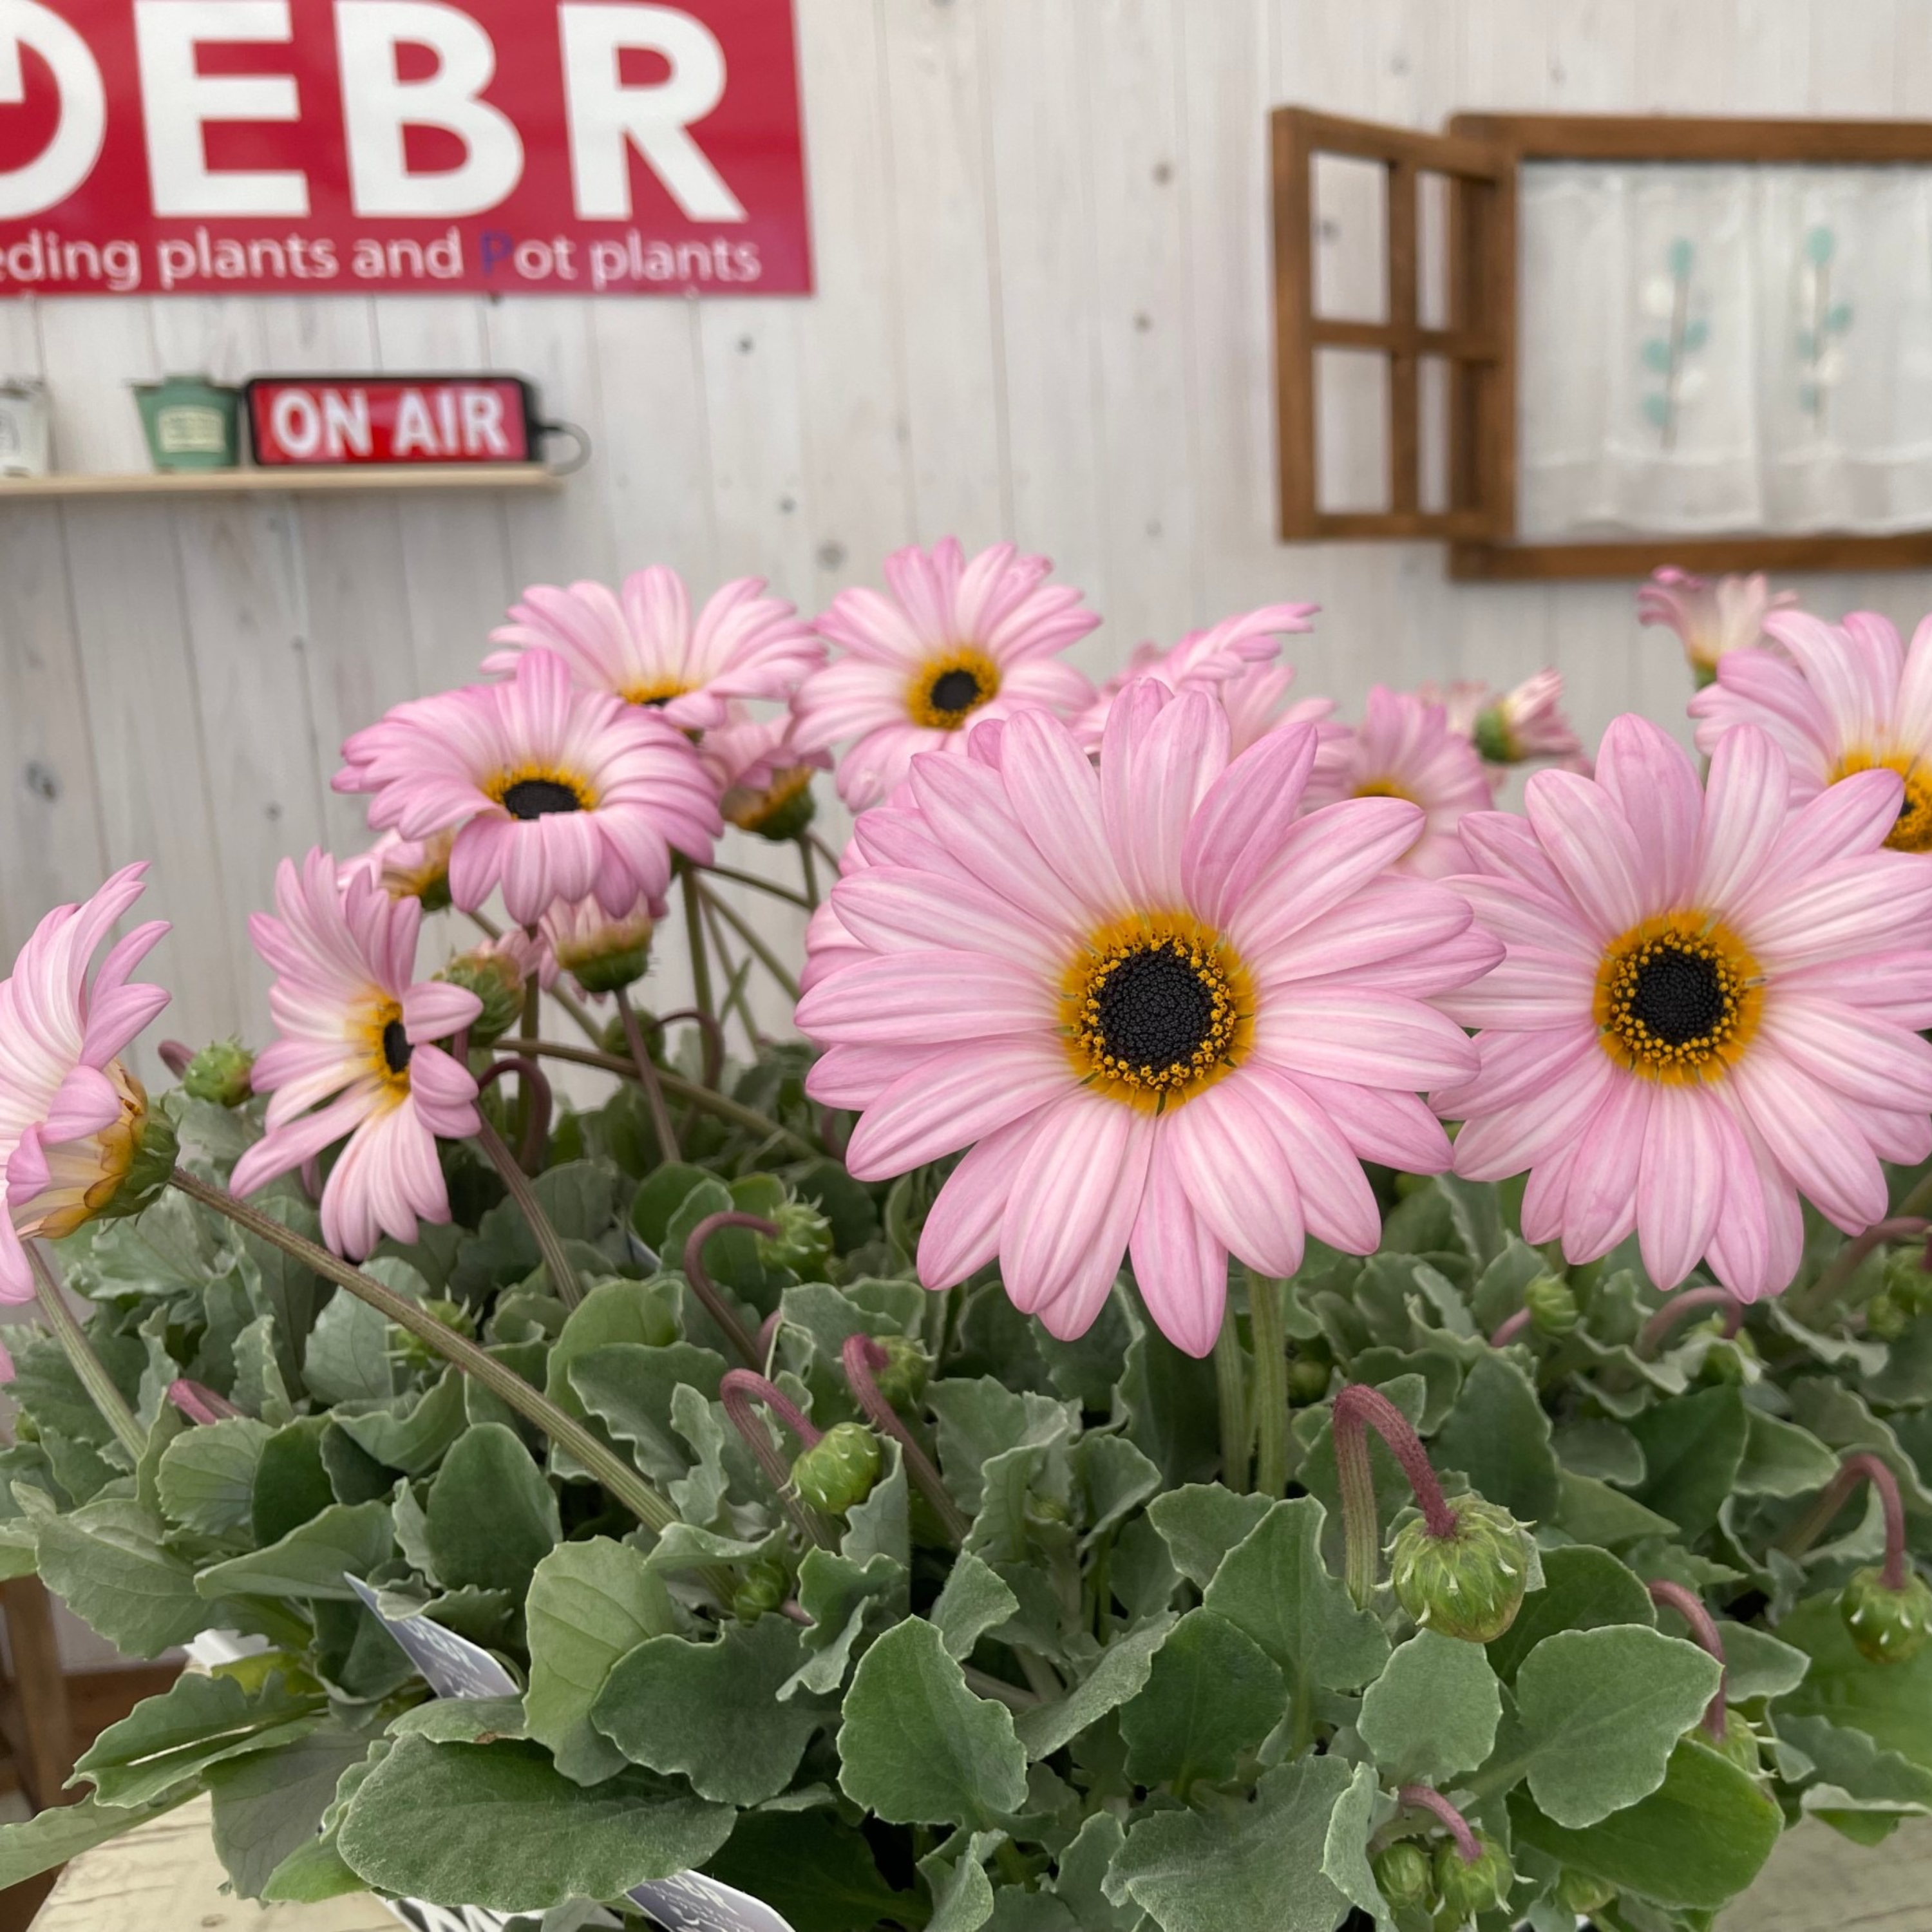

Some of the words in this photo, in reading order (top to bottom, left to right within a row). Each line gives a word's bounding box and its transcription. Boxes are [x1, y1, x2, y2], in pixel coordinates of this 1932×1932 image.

[0, 228, 141, 291] ding
[156, 225, 339, 290] plants
[352, 226, 462, 279] and
[479, 230, 578, 280] Pot
[589, 227, 762, 292] plants
[271, 387, 374, 458] ON
[390, 386, 509, 457] AIR
